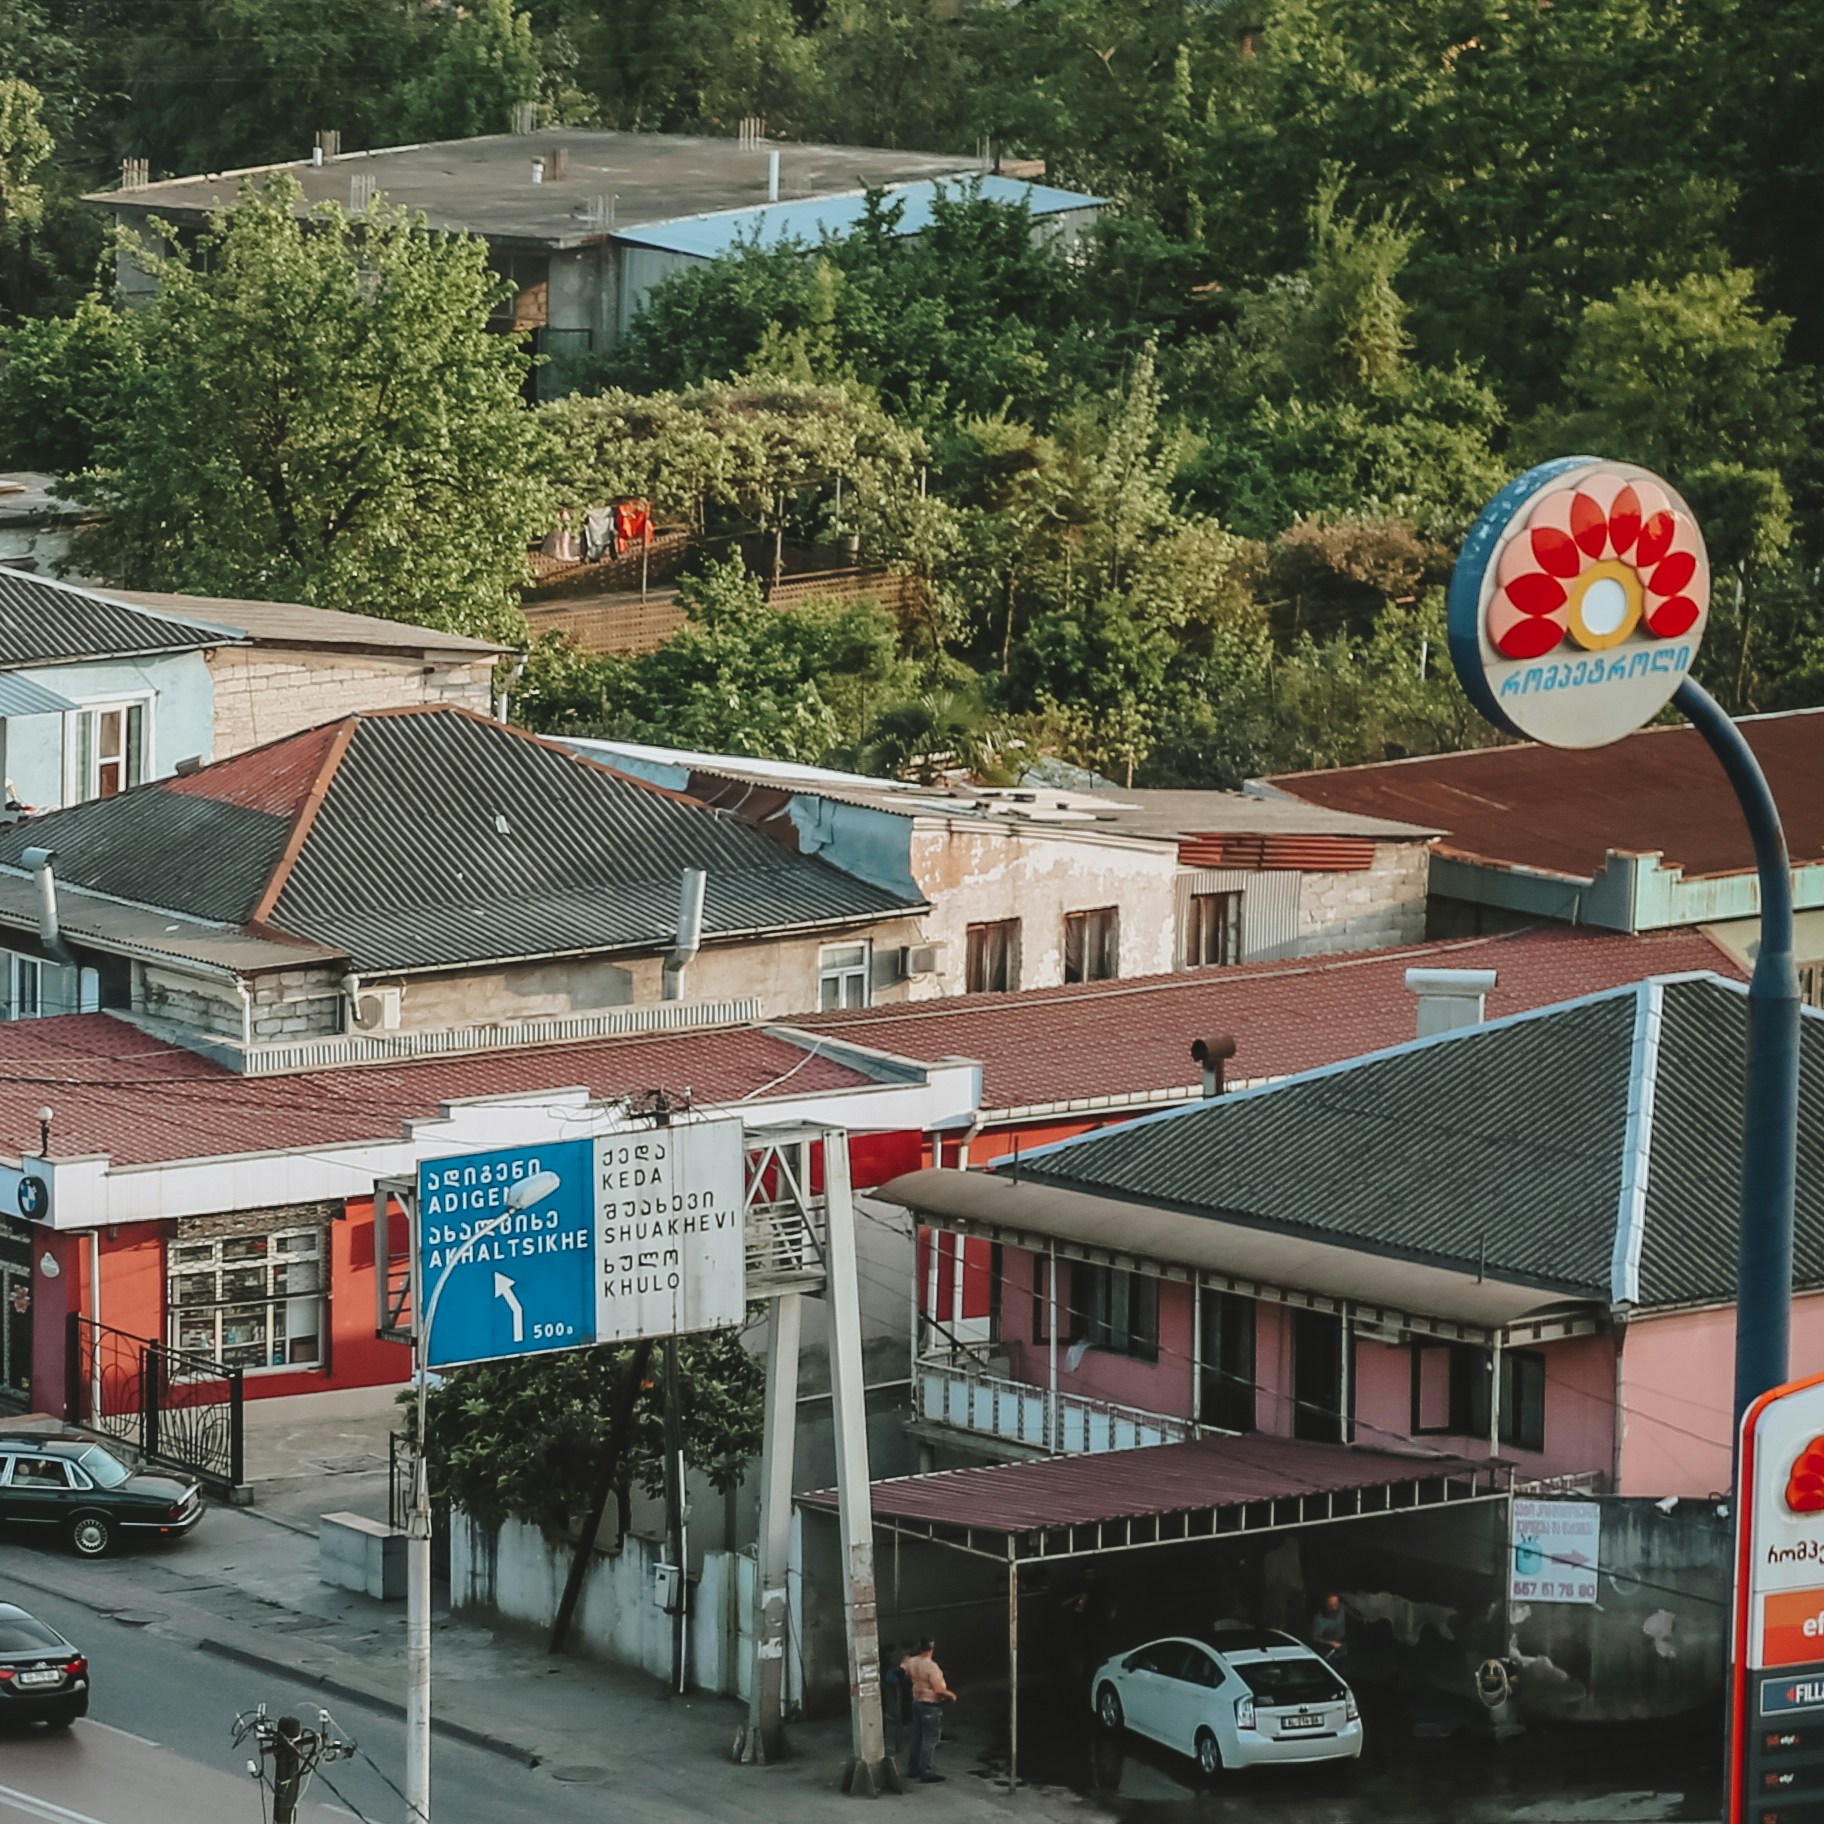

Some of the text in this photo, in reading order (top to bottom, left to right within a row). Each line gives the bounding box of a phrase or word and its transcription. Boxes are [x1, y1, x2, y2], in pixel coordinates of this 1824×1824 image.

[1499, 645, 1691, 697] რომპეტროლი
[602, 1143, 666, 1167] ქედა
[427, 1158, 541, 1192] ადიგენი
[602, 1167, 663, 1191] KEDA
[603, 1190, 714, 1220] შუახევი
[604, 1211, 736, 1244] SHUAKHEVI
[429, 1229, 589, 1269] AKHALTSIKHE
[604, 1248, 679, 1275] ხულო
[604, 1272, 680, 1298] KHULO
